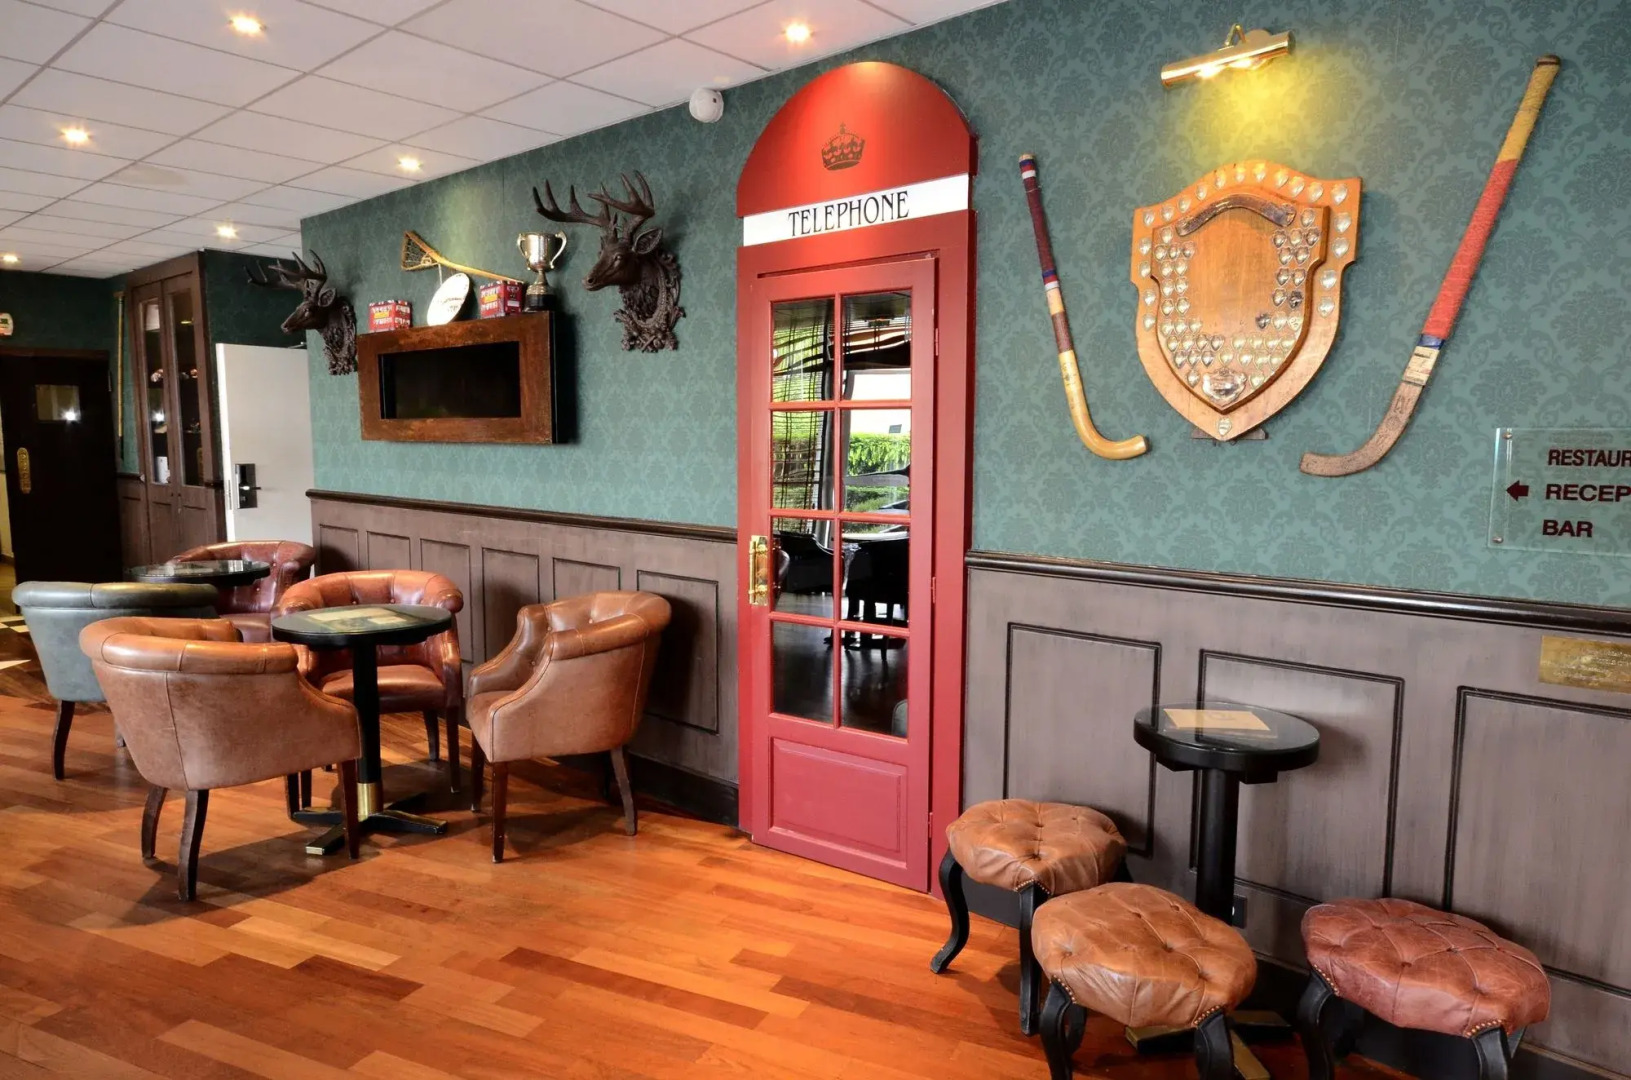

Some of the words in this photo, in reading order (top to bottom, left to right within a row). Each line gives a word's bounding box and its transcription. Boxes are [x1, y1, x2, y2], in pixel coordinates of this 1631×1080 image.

[788, 190, 909, 237] TELEPHONE
[1545, 483, 1631, 502] RECEP
[1542, 519, 1593, 538] BAR
